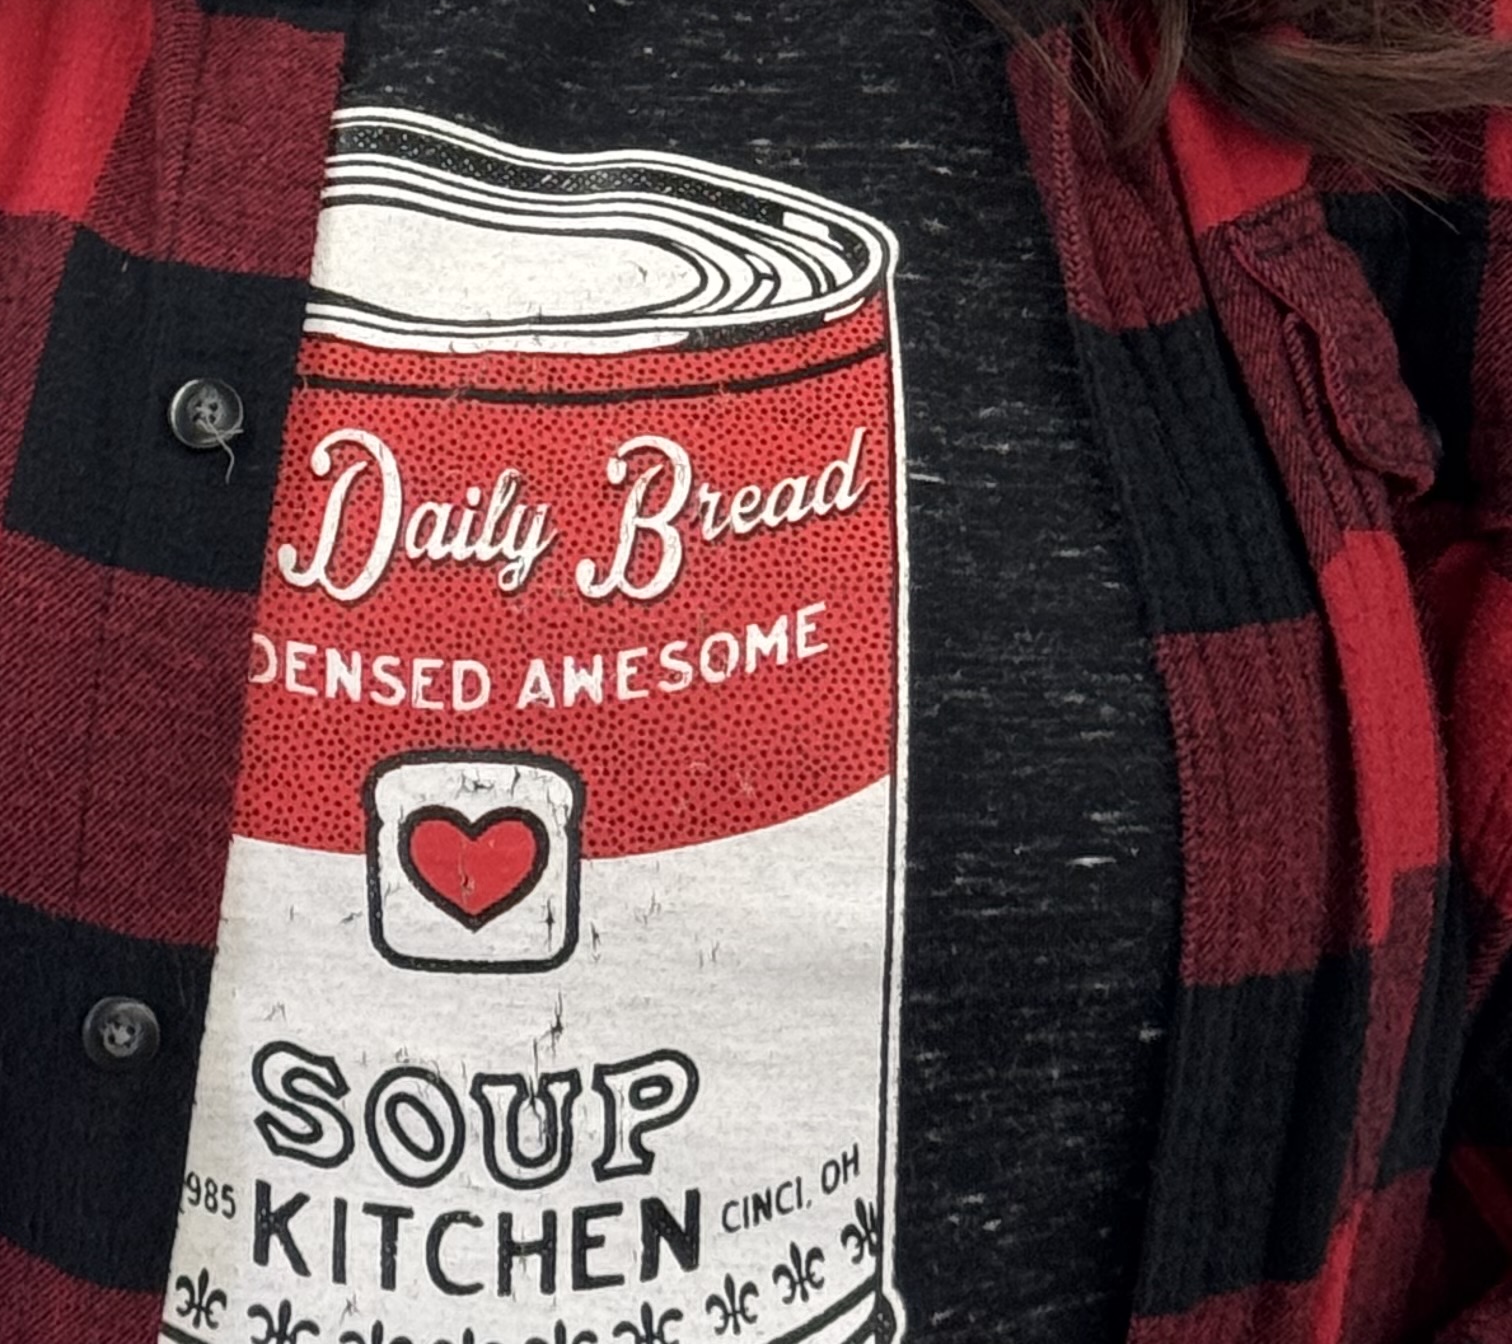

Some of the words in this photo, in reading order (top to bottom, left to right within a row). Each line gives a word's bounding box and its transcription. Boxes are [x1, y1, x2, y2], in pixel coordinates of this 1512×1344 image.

[278, 428, 558, 602] Daily
[576, 427, 870, 600] Bread
[516, 602, 828, 710] AWESOME
[251, 1040, 700, 1189] SOUP
[821, 1142, 860, 1195] OH
[179, 1170, 237, 1220] 985
[253, 1178, 701, 1297] KITCHEN
